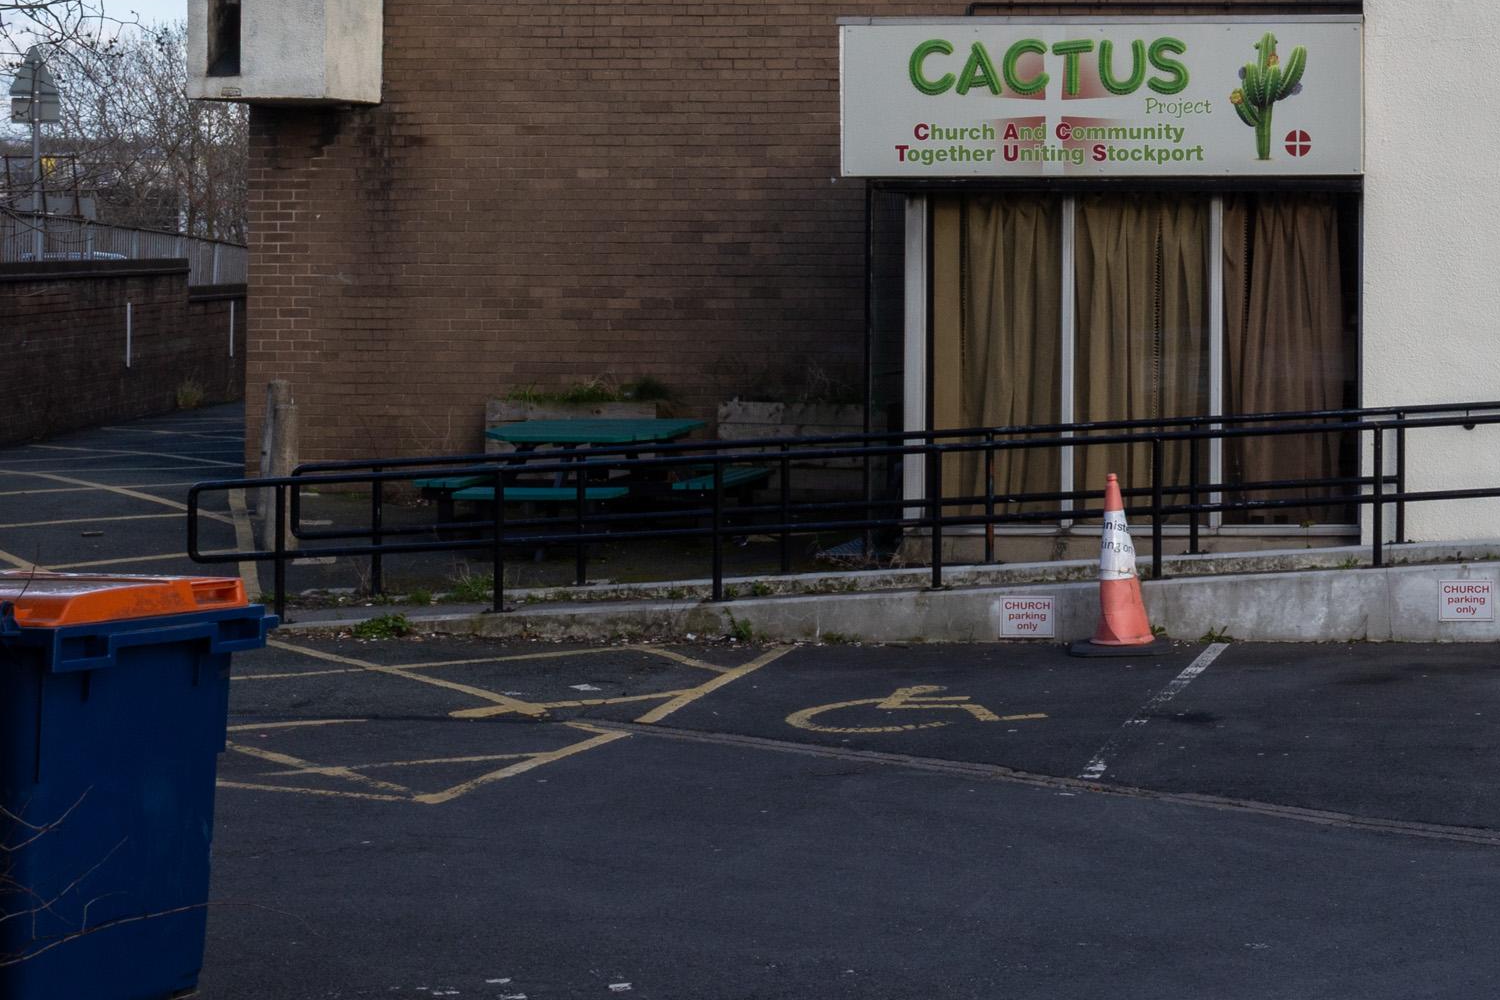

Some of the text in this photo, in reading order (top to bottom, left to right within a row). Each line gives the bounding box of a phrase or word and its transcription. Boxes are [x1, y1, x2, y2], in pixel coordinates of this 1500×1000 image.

[908, 37, 1189, 96] CACTUS
[1145, 97, 1212, 118] Project
[913, 123, 1184, 143] Church And Community
[895, 144, 1204, 165] Together Uniting Stockport
[1443, 585, 1489, 593] CHURCH
[1447, 595, 1486, 605] parking
[1004, 601, 1051, 610] CHURCH
[1456, 605, 1477, 615] only
[1008, 611, 1047, 621] parking
[1017, 621, 1038, 632] only
